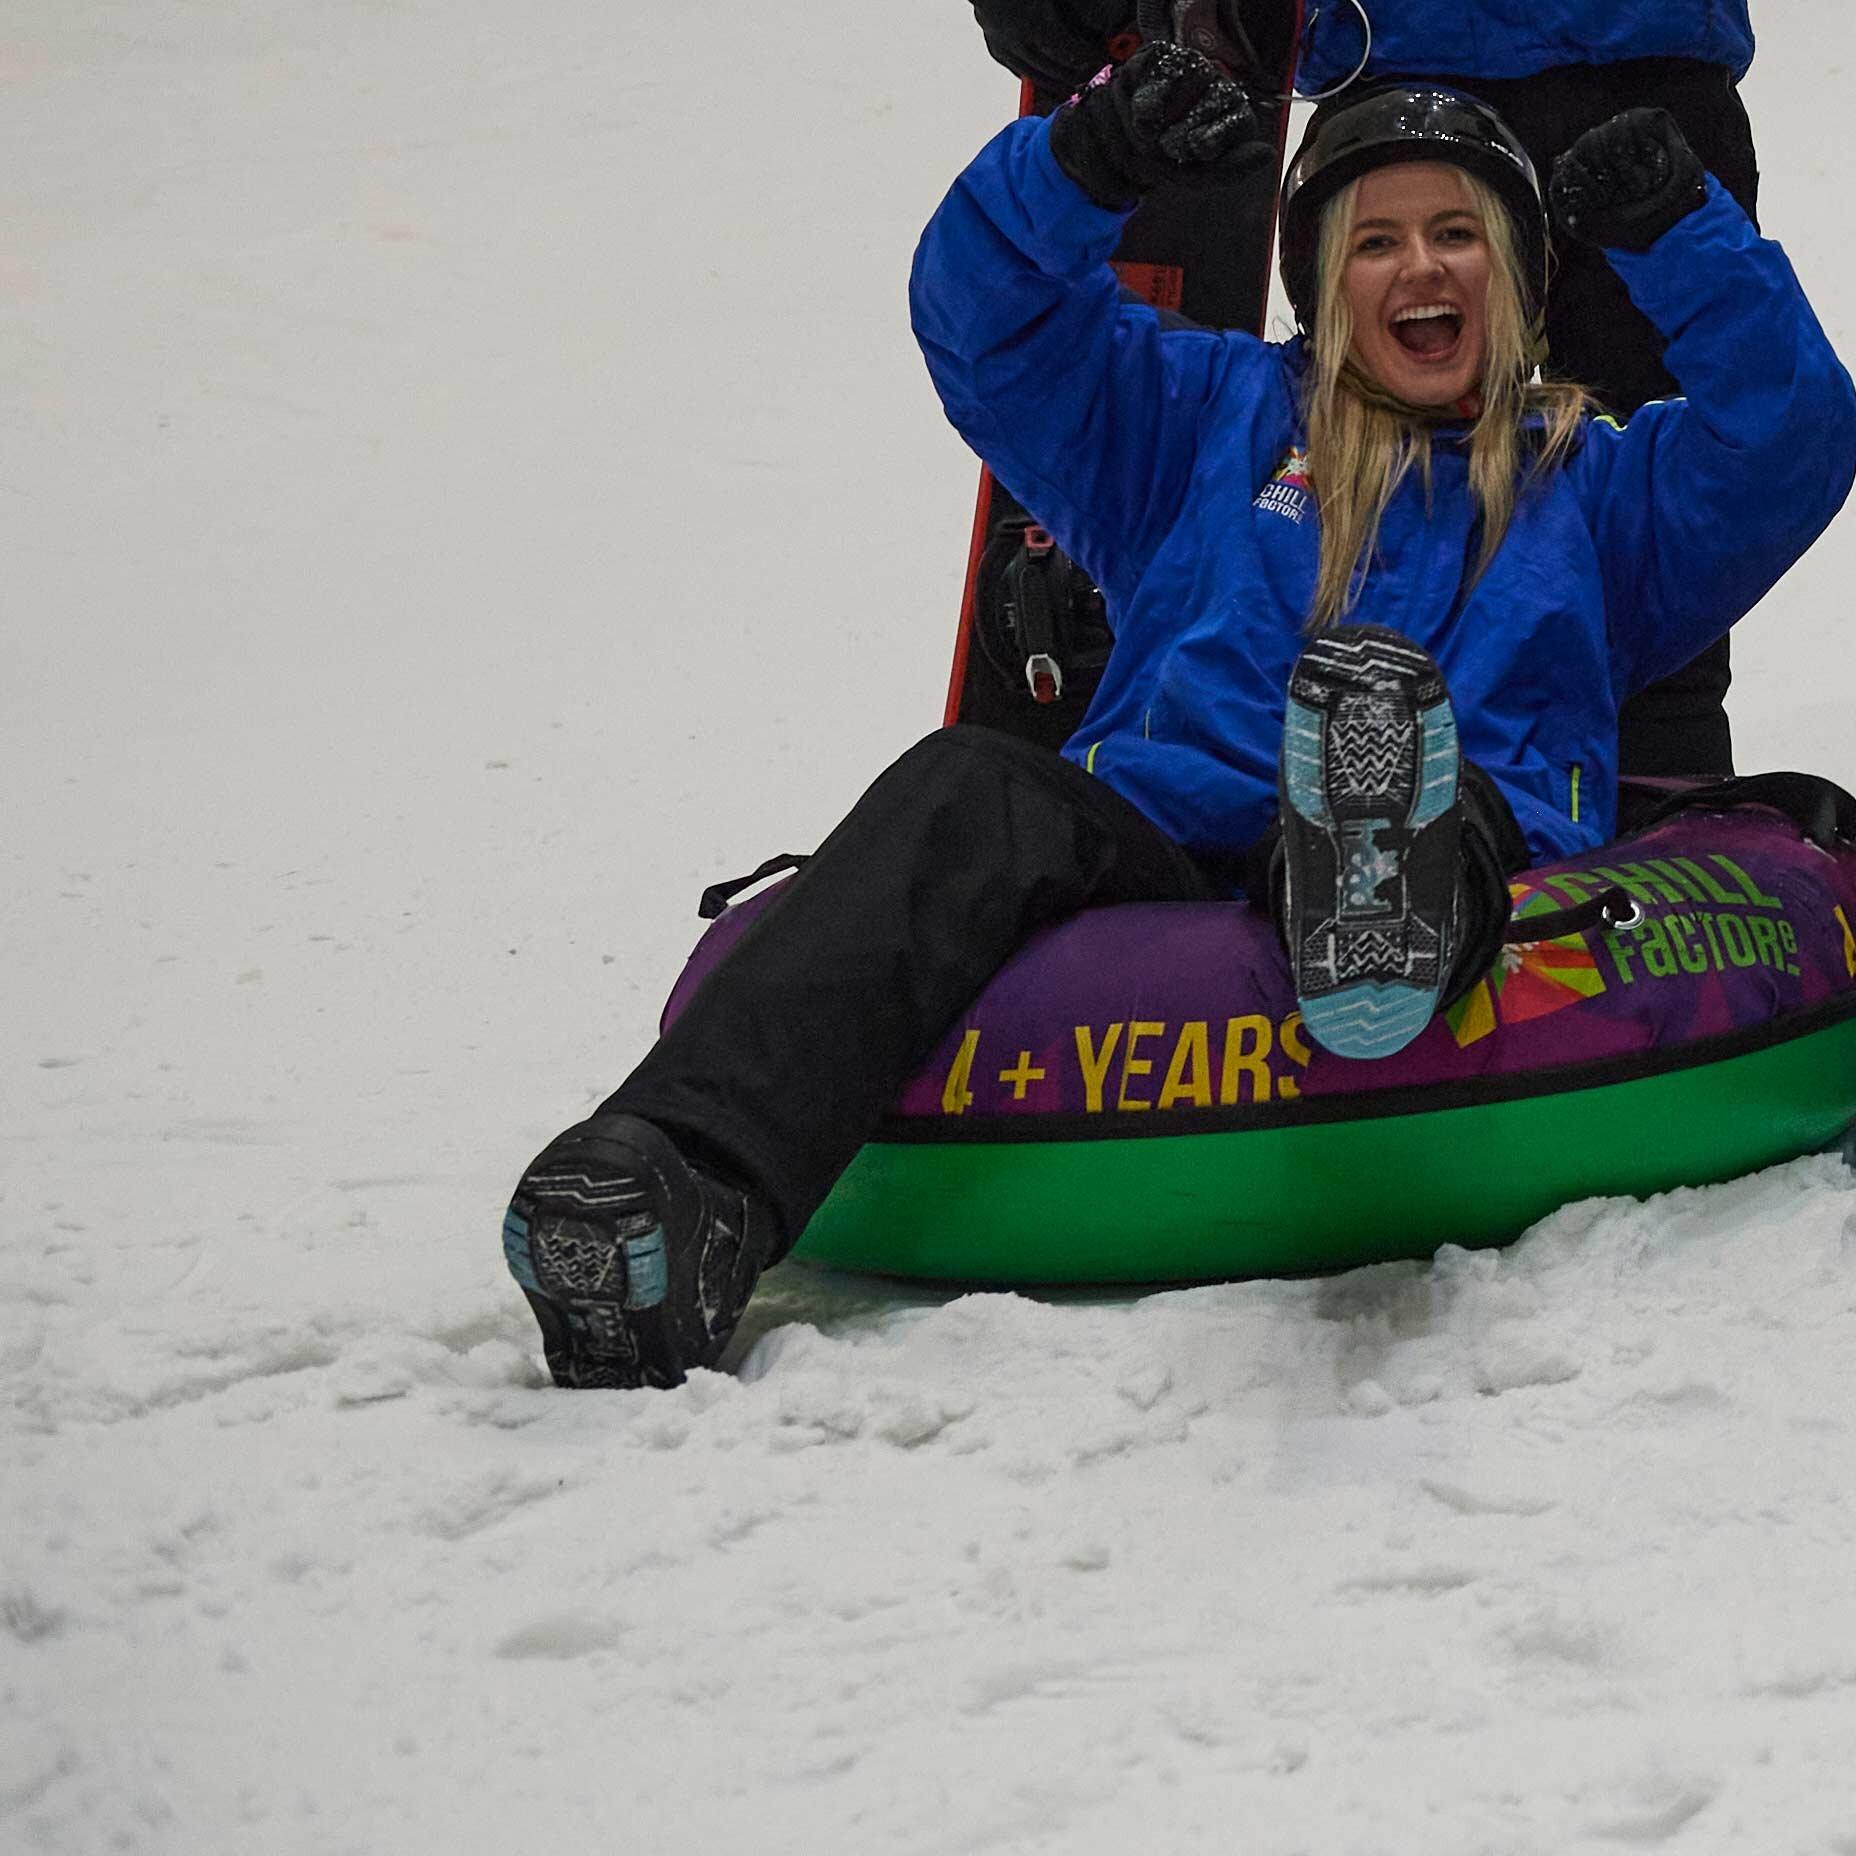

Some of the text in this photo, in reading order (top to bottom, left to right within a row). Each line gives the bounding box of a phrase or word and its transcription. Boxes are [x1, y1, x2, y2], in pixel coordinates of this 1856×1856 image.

[1259, 482, 1308, 515] CHILL
[1545, 854, 1782, 910] CHILL
[1074, 1010, 1312, 1113] YEARS
